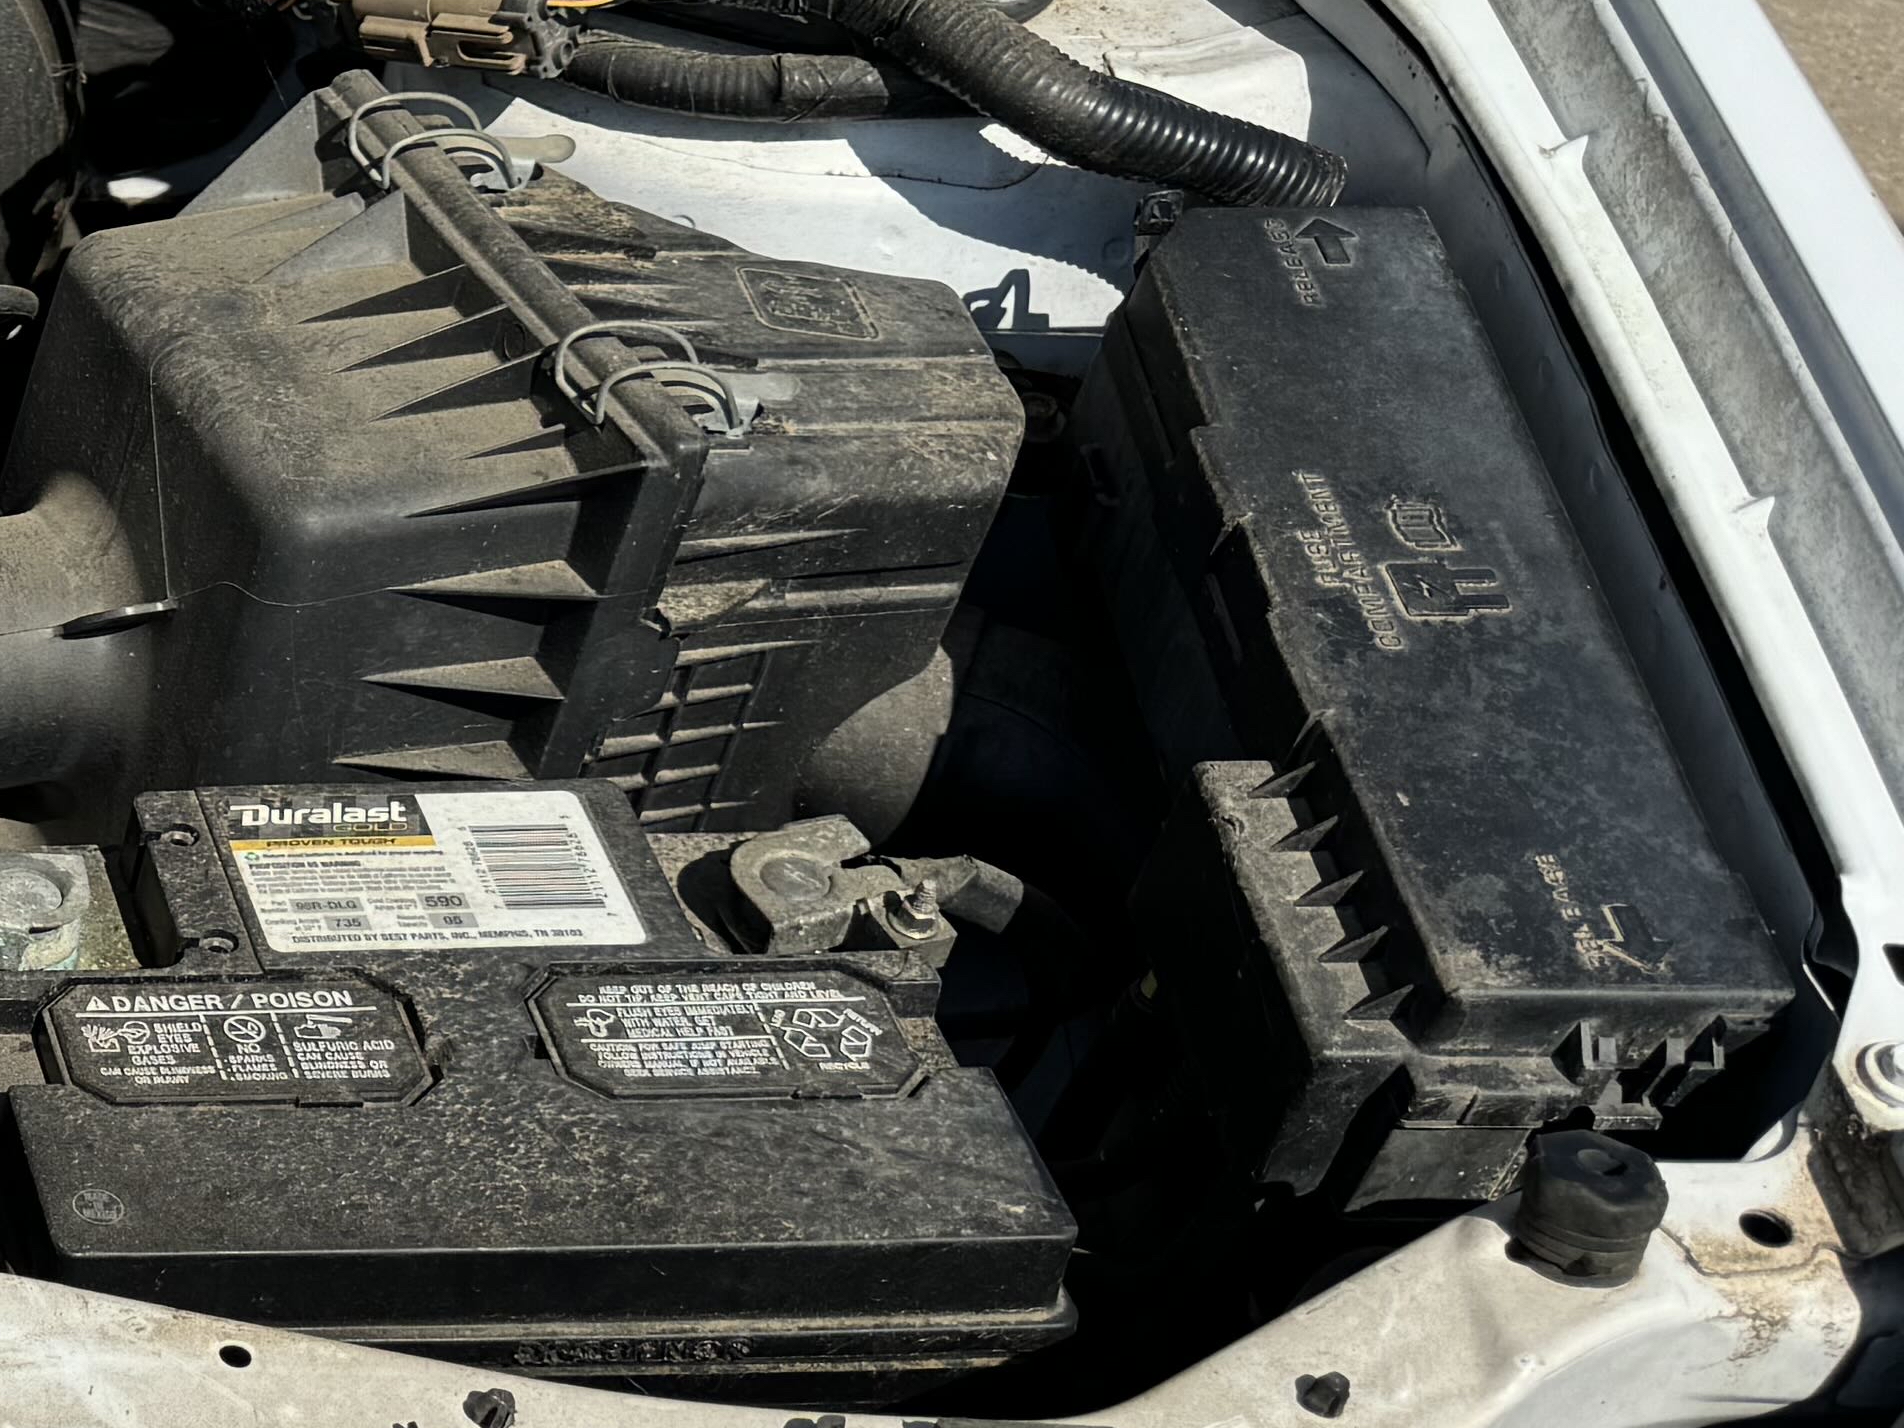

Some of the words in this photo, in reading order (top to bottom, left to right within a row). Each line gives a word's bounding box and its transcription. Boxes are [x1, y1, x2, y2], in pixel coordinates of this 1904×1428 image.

[1298, 471, 1406, 651] COMPARTMENT
[229, 801, 407, 826] Duralast
[333, 823, 407, 832] GOLD
[266, 839, 334, 847] PROVEN
[339, 838, 396, 846] TOUGH
[423, 895, 463, 908] 590
[335, 918, 362, 928] 735
[112, 995, 223, 1012] DANGER
[232, 993, 243, 1010] /
[252, 990, 354, 1008] POISON
[153, 1022, 202, 1033] SHIELD
[157, 1033, 192, 1043] EYES
[127, 1043, 201, 1054] EXPLOSIVE
[237, 1044, 261, 1054] NO
[293, 1041, 359, 1052] SULFURIC
[363, 1040, 395, 1051] ACID
[132, 1055, 176, 1065] GASES
[297, 1052, 322, 1061] CAN
